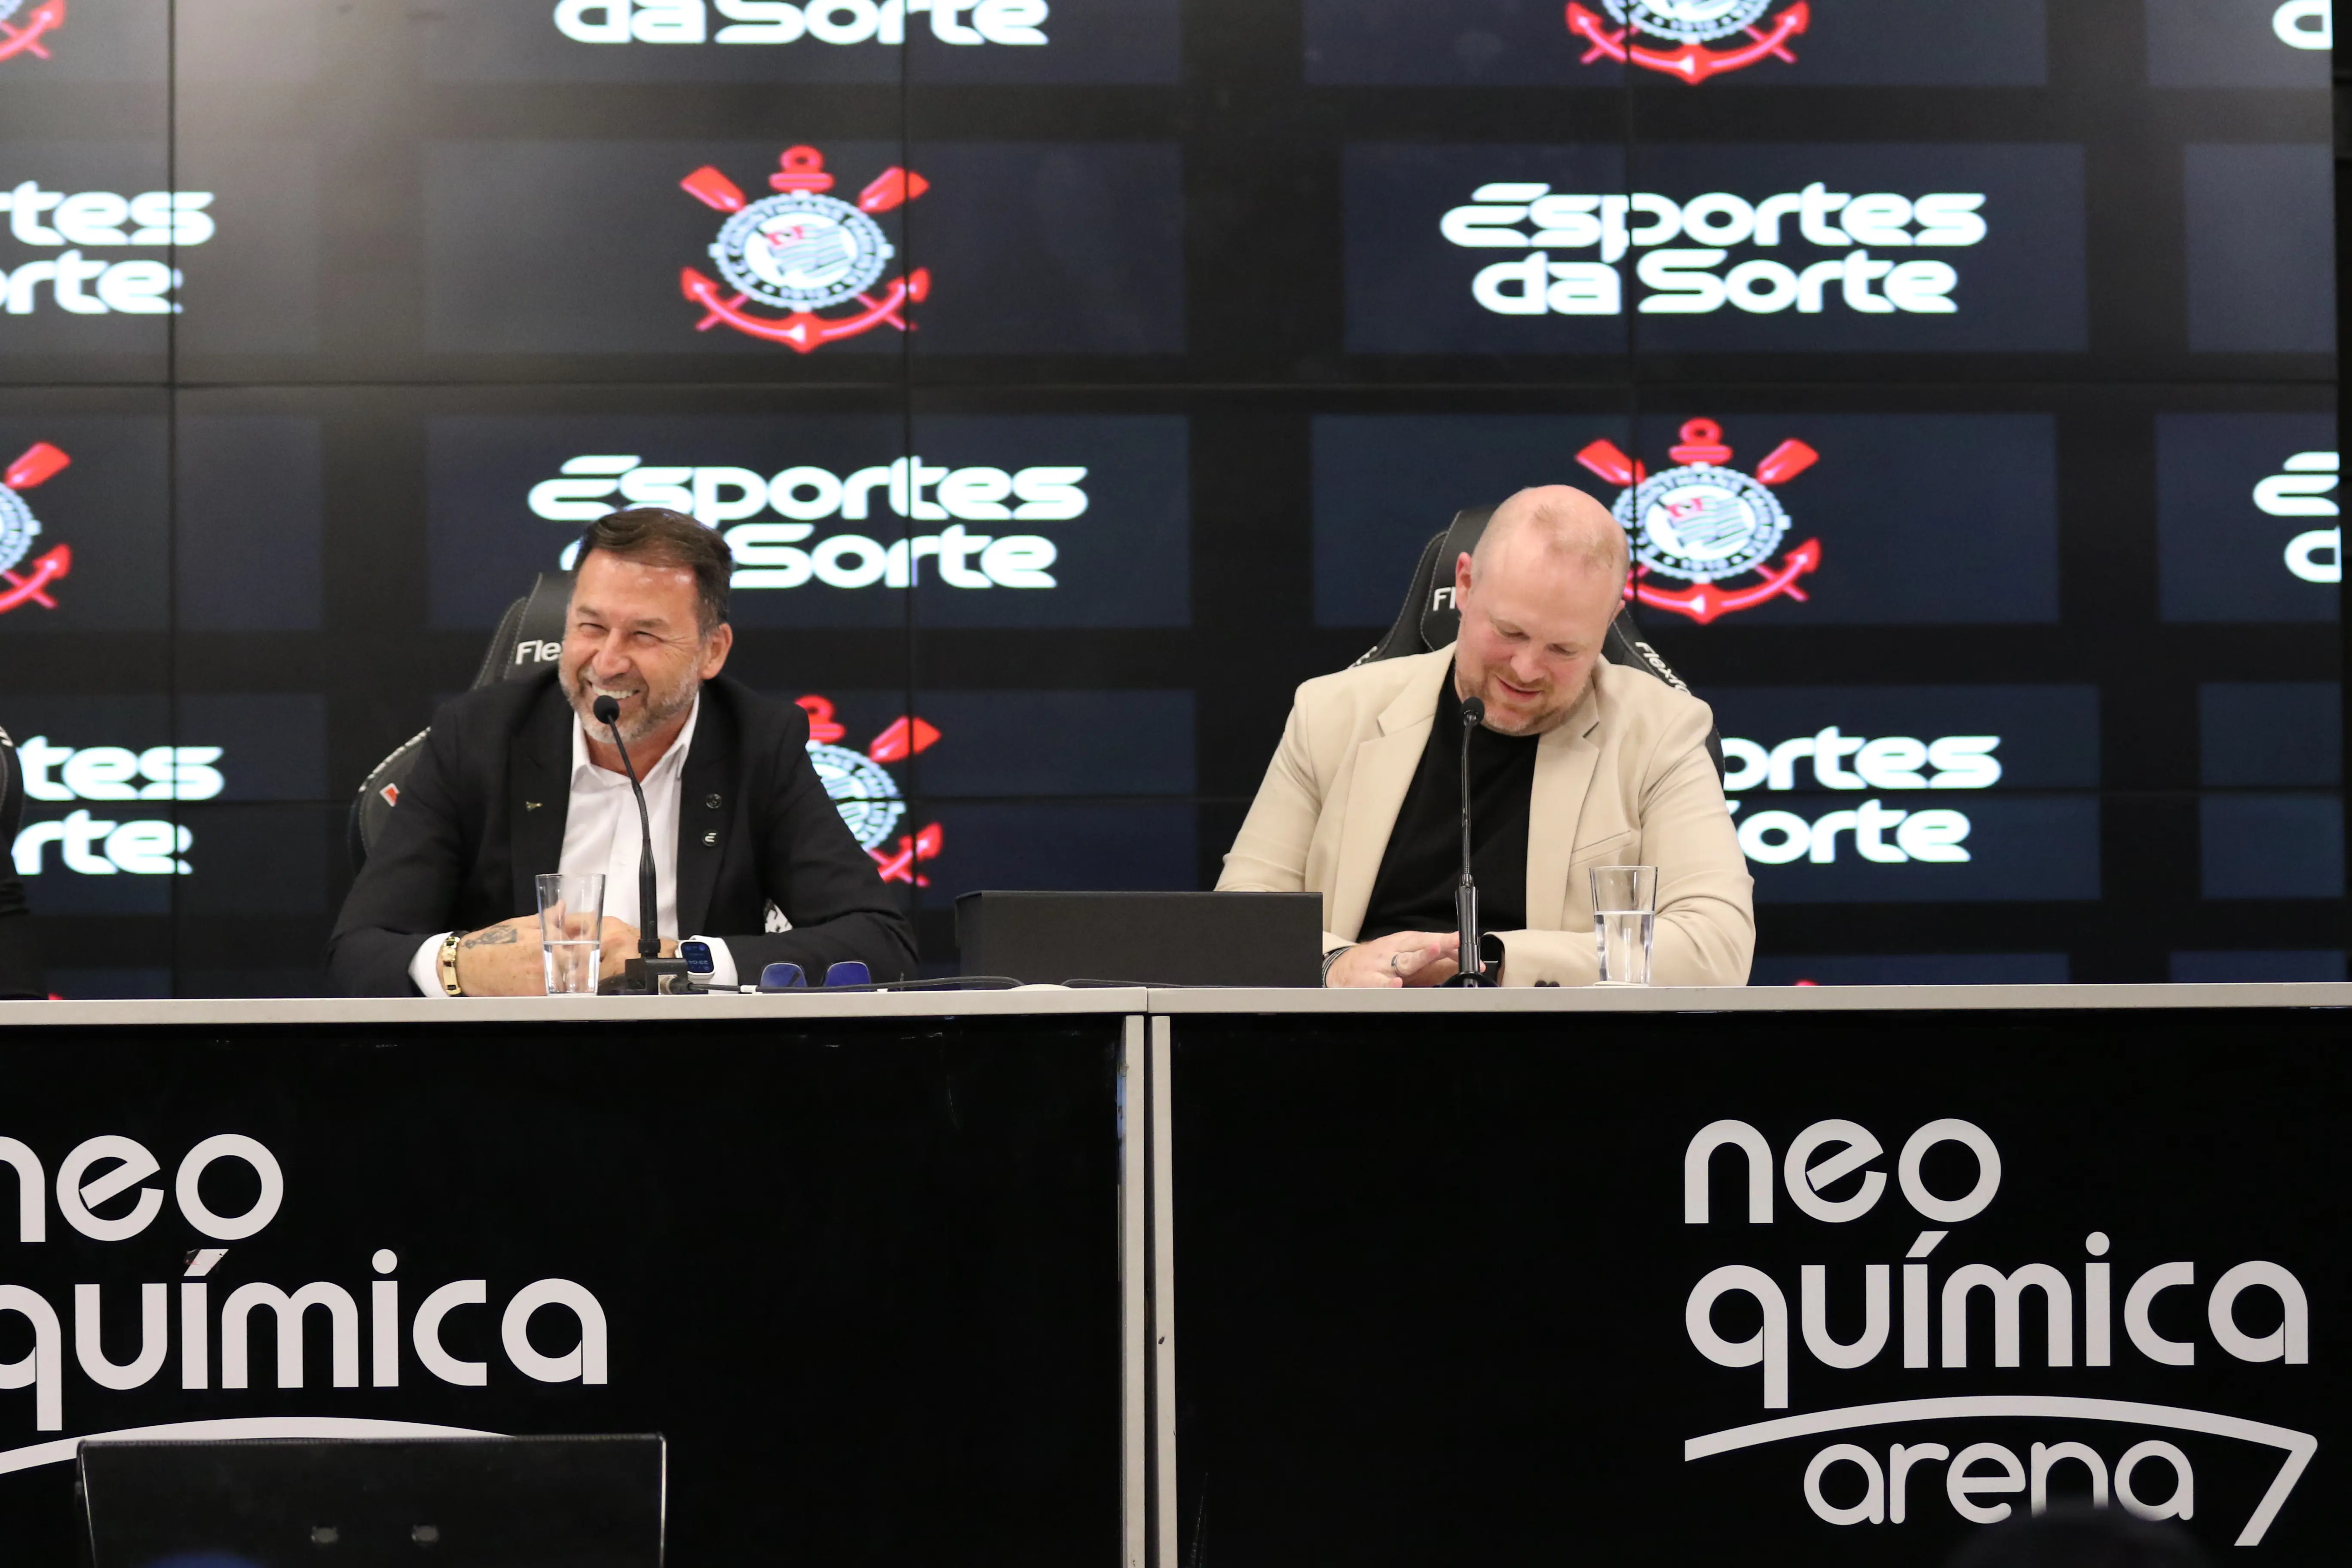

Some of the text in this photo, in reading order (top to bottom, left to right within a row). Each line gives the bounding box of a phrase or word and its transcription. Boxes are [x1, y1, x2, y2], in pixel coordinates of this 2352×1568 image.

[0, 180, 215, 246] tes
[1440, 182, 1987, 263] Esportes
[0, 249, 183, 315] rte
[1473, 249, 1957, 315] da Sorte
[528, 455, 1088, 530] Esportes
[1727, 799, 1971, 863] orte
[1684, 1118, 2001, 1224] neo
[1685, 1230, 2309, 1409] química
[1804, 1440, 2194, 1525] arena
